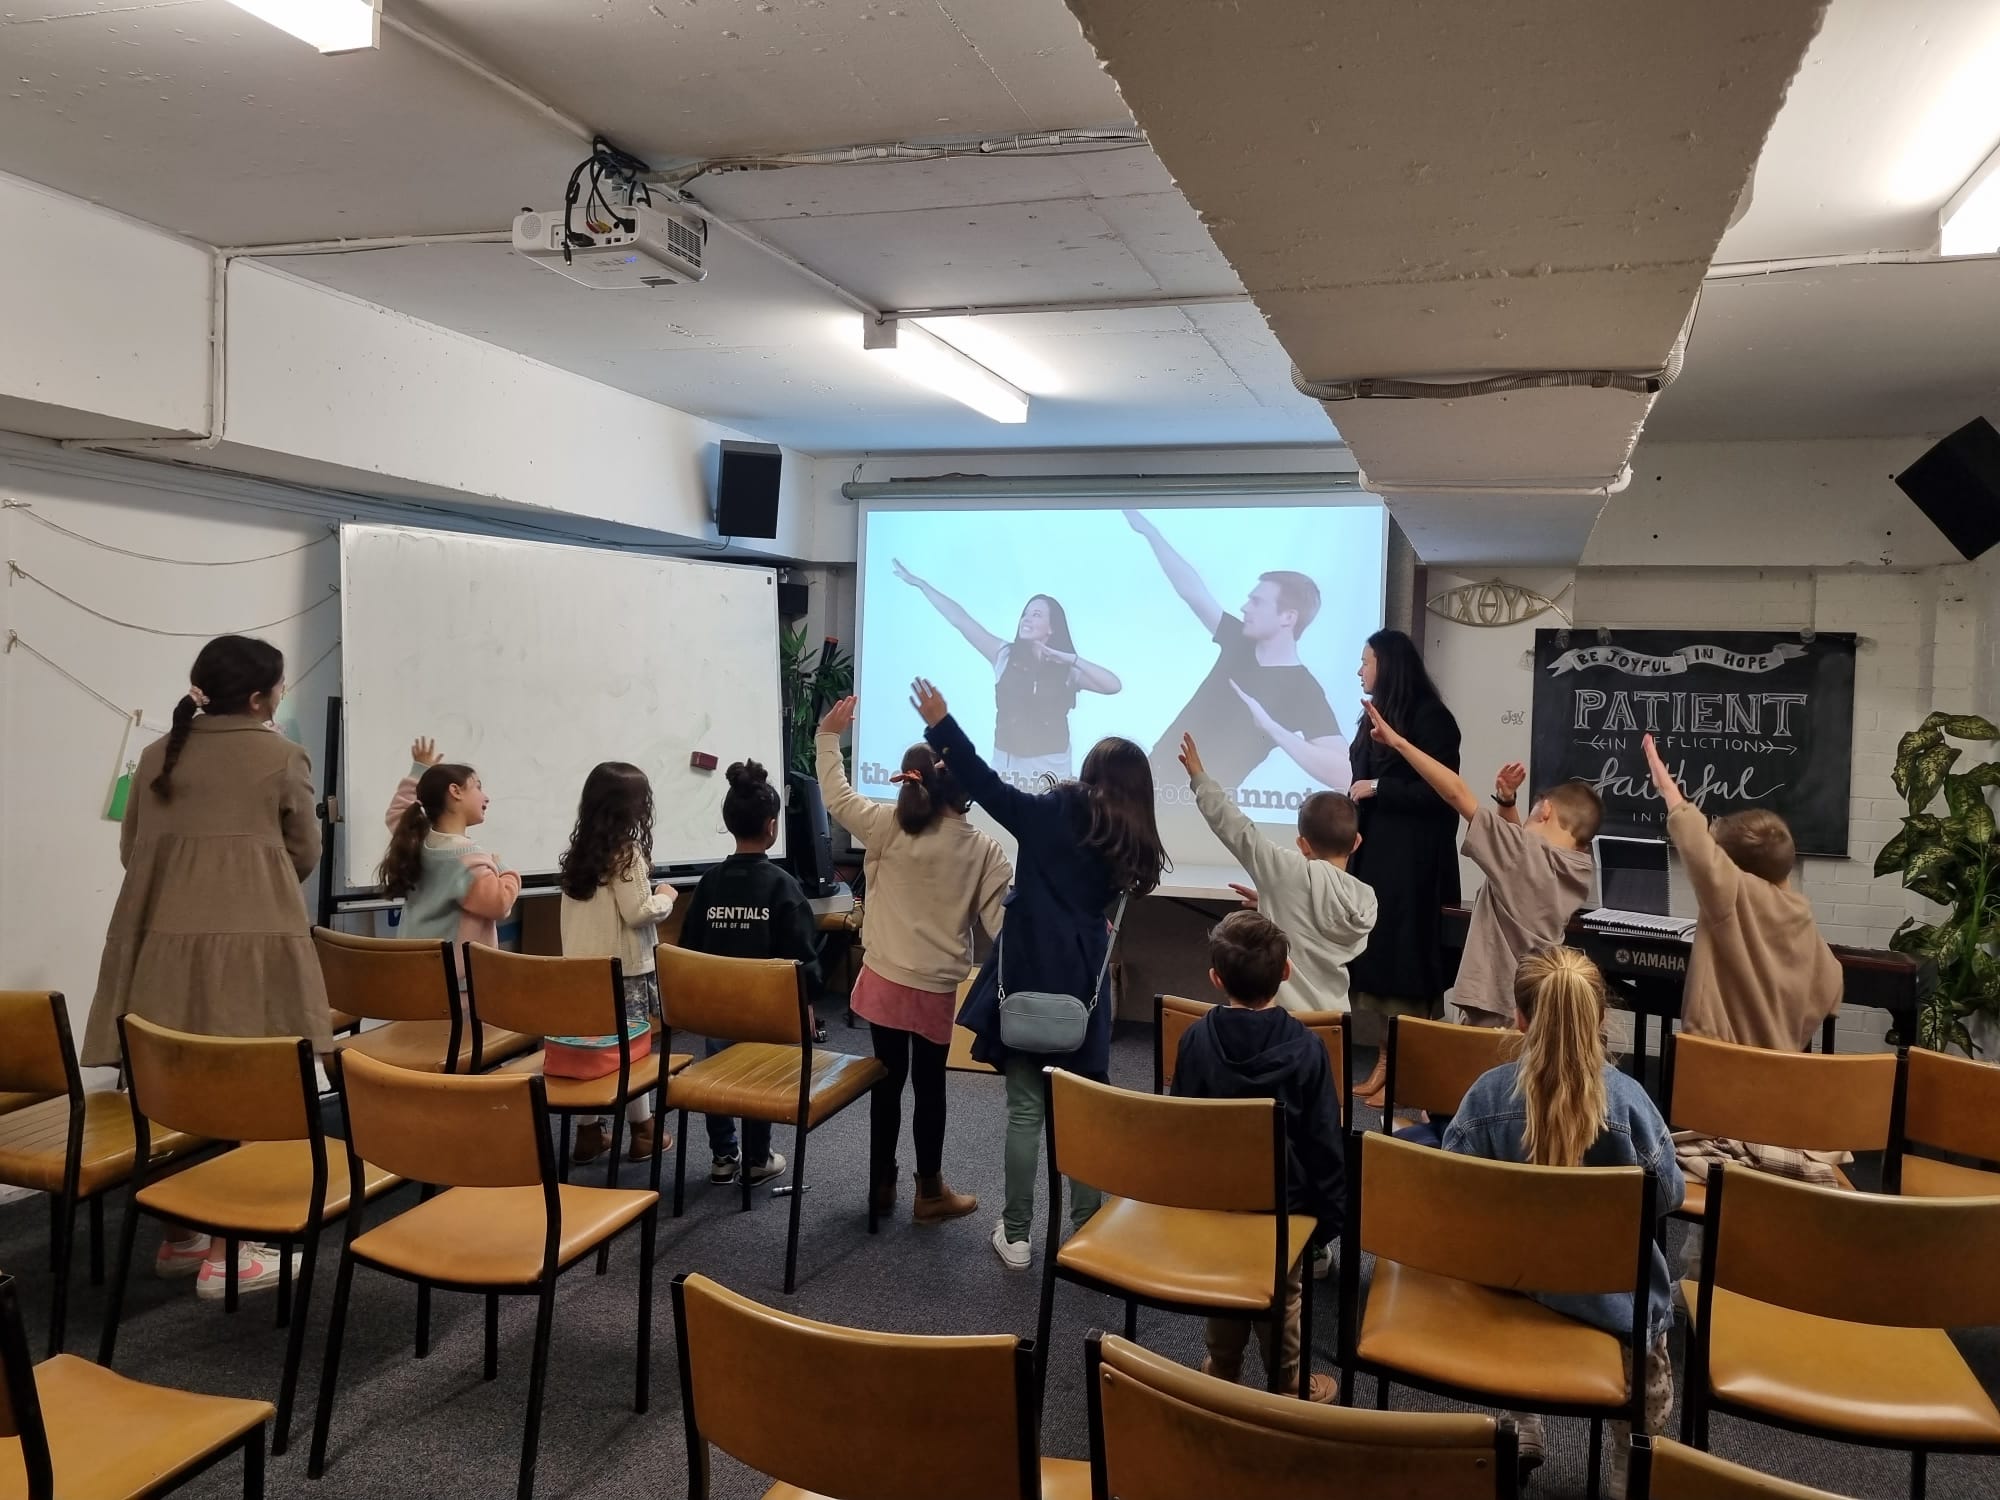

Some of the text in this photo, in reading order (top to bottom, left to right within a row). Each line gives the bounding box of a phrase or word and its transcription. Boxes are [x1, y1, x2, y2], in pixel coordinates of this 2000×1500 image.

[1577, 648, 1768, 673] BE JOYFUL IN HOPE
[1573, 689, 1809, 737] PATIENT
[1608, 736, 1759, 753] IN FFLICTION
[1223, 786, 1313, 811] anno
[1632, 812, 1652, 822] IN
[707, 906, 770, 920] SENTIALS
[1631, 950, 1686, 972] YAMAHA
